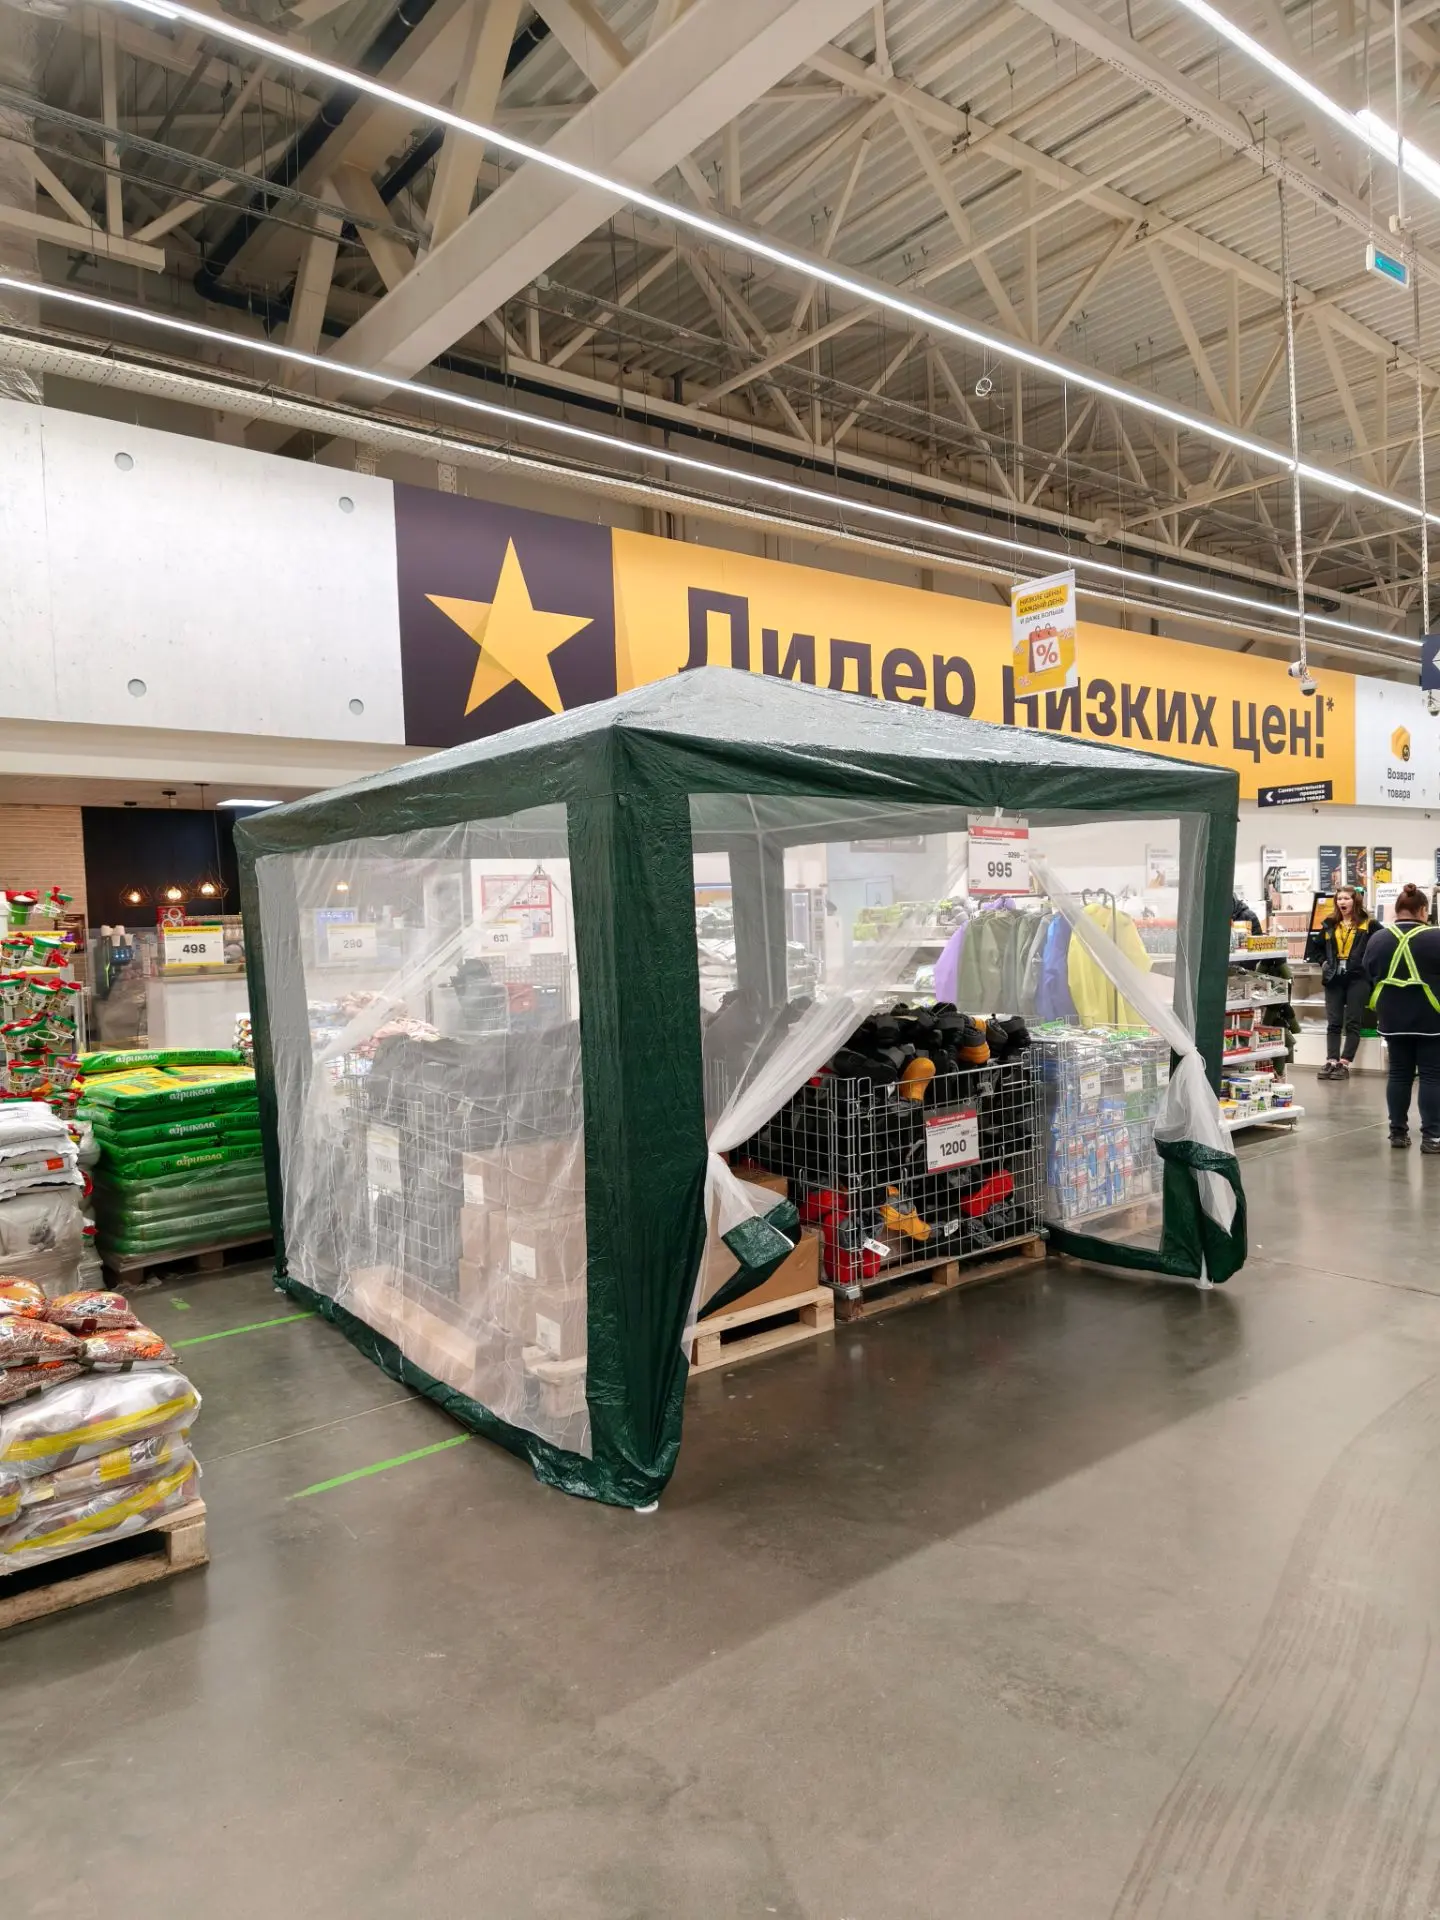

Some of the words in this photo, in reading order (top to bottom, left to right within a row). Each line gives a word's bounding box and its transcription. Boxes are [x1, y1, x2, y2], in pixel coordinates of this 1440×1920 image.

[678, 586, 976, 719] Лидер
[1387, 767, 1416, 783] Возврат
[1387, 788, 1411, 801] товара
[987, 861, 1013, 878] 995
[182, 943, 207, 954] 498
[939, 1139, 967, 1157] 1200
